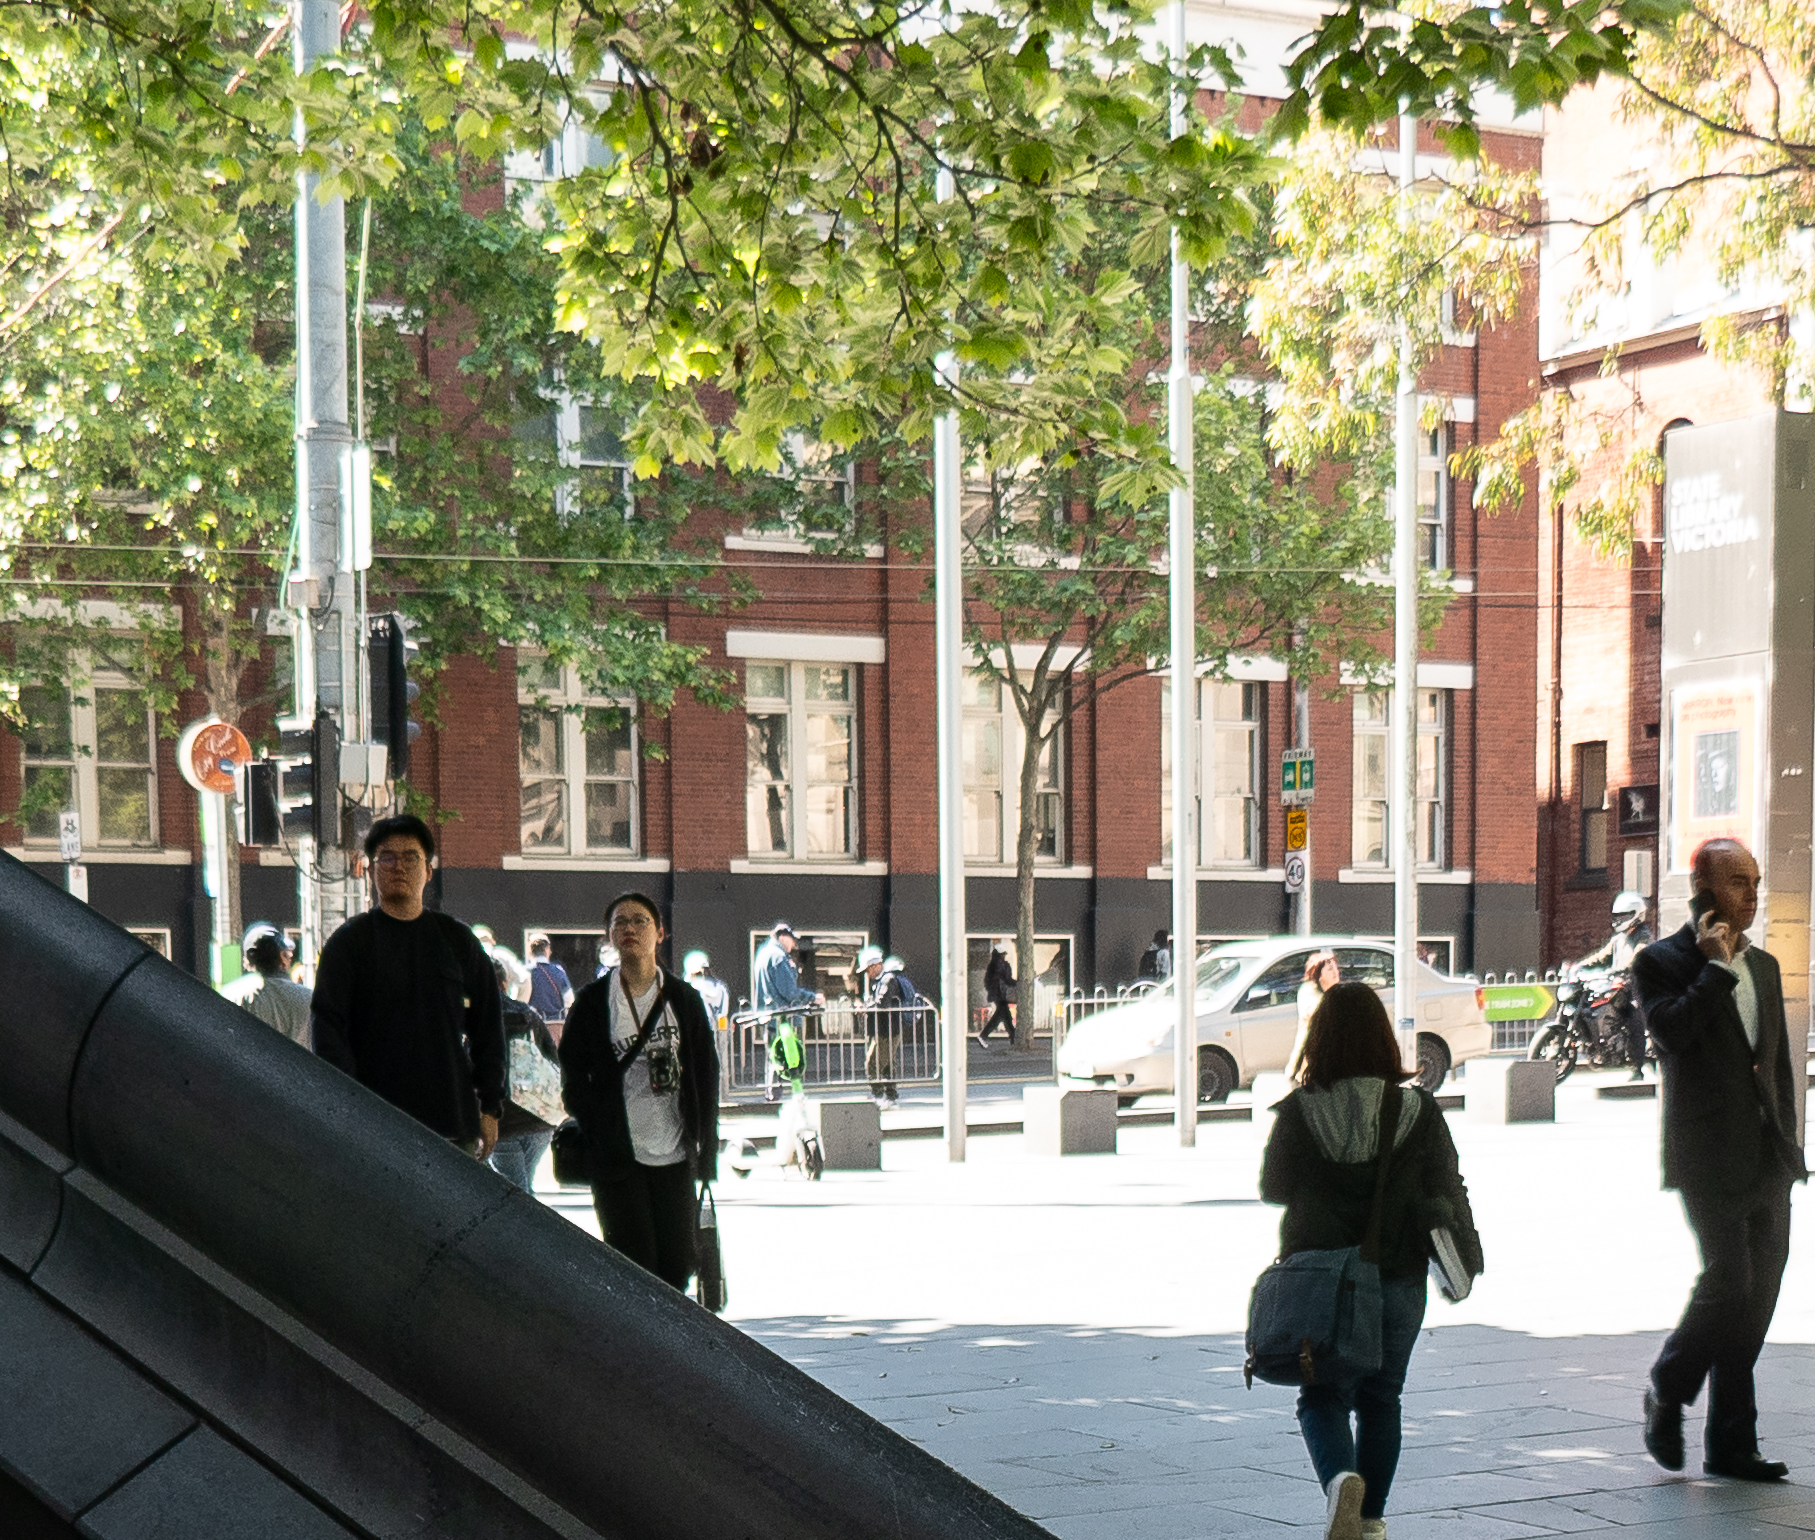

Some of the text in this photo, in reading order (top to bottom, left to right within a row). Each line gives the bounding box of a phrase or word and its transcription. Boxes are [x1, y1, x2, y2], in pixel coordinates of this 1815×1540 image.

[1671, 472, 1719, 506] STATE
[1670, 493, 1743, 529] LIBRARY
[1671, 517, 1758, 554] VICTORIA
[1288, 864, 1303, 879] 40
